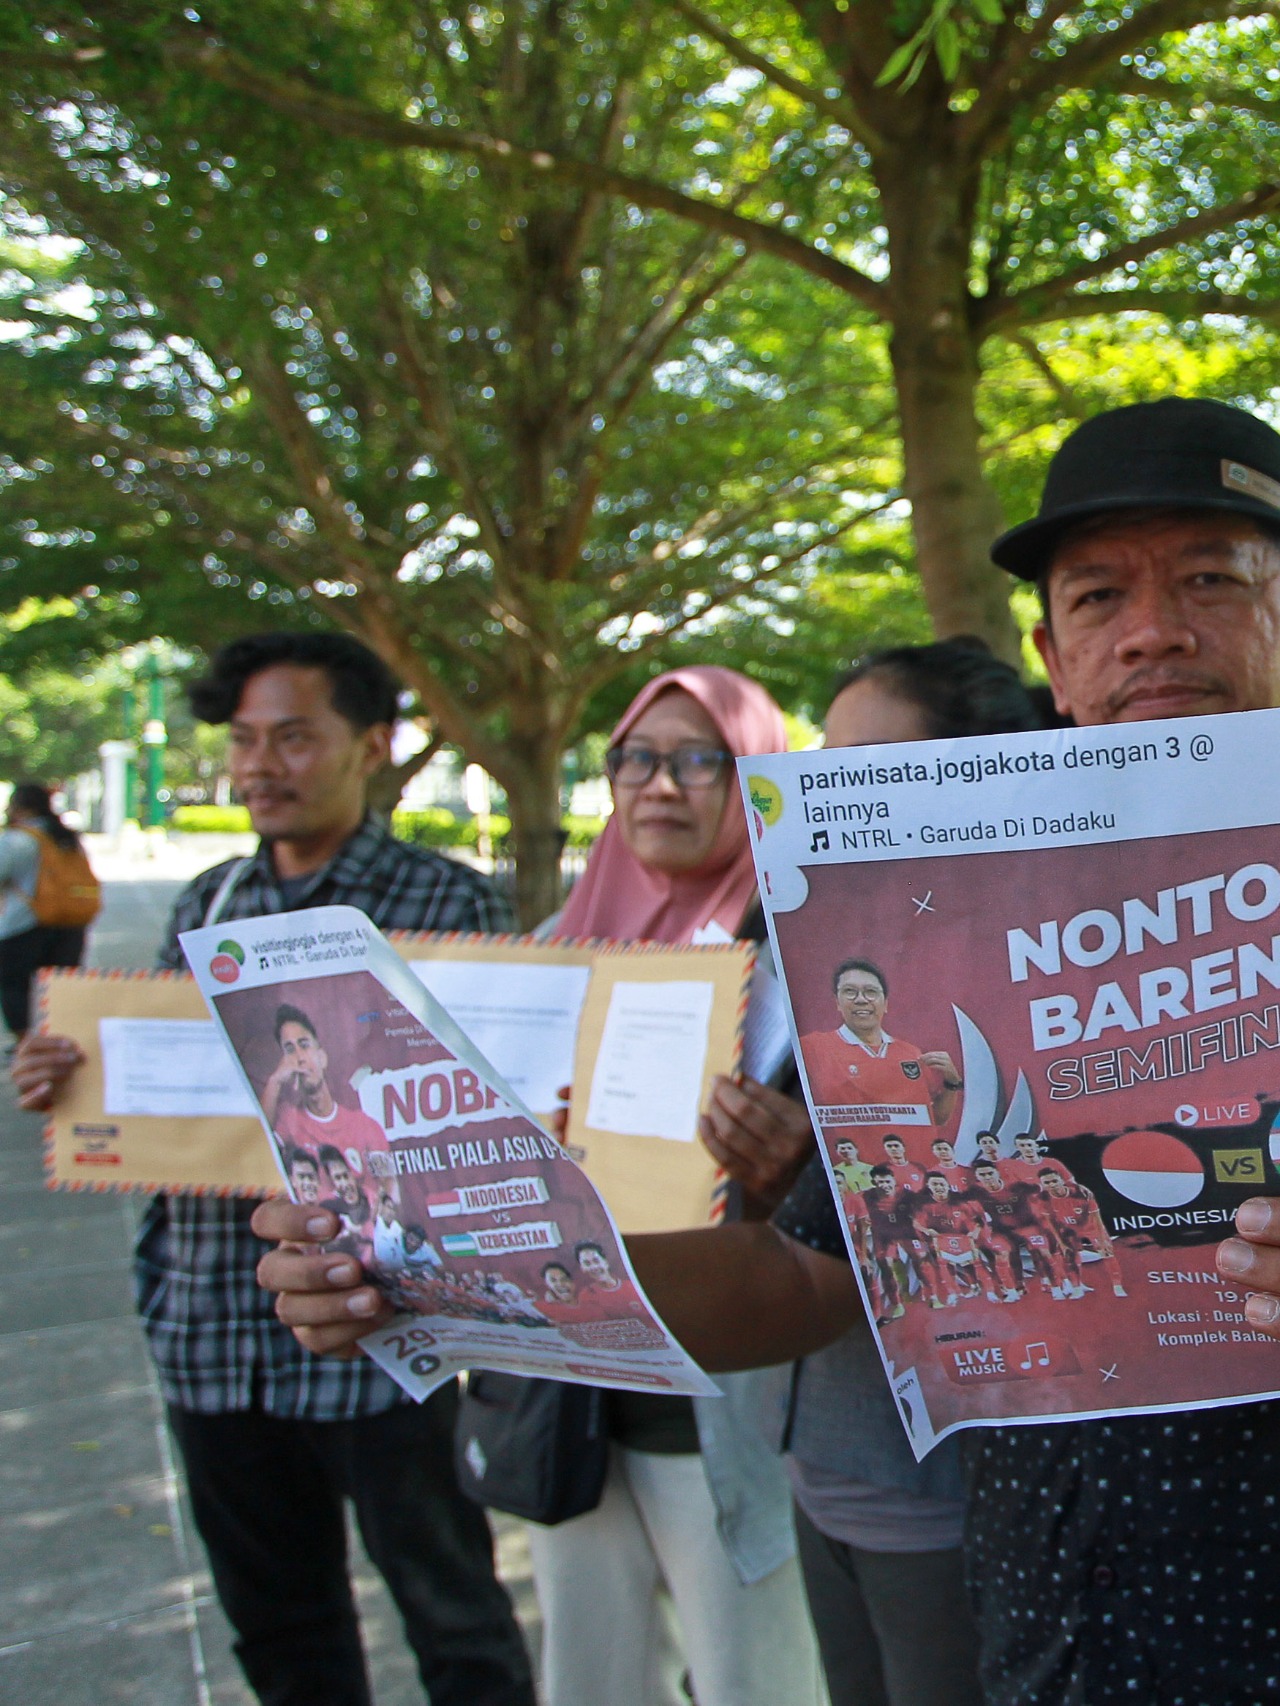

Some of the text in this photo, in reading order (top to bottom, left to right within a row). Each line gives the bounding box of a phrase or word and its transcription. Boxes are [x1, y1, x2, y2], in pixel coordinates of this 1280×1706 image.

[800, 735, 1214, 796] pariwisata.jogjakota dengan 3 @
[804, 801, 890, 825] lainnya
[841, 811, 1116, 849] NTRL Garuda Di Dadaku
[1204, 1103, 1250, 1121] LIVE
[447, 1138, 501, 1168] PIALA
[503, 1135, 544, 1162] ASIA
[1220, 1156, 1256, 1176] VS
[465, 1183, 539, 1208] INDONESIA
[478, 1229, 549, 1250] UZBEKISTAN
[1147, 1271, 1226, 1286] SENIN,
[1148, 1310, 1201, 1324] Lokasi
[1213, 1309, 1248, 1324] Dep
[383, 1328, 438, 1360] 29
[1157, 1330, 1276, 1347] Komplek Bala
[953, 1347, 1004, 1367] LIVE
[959, 1362, 1006, 1377] MUSIC
